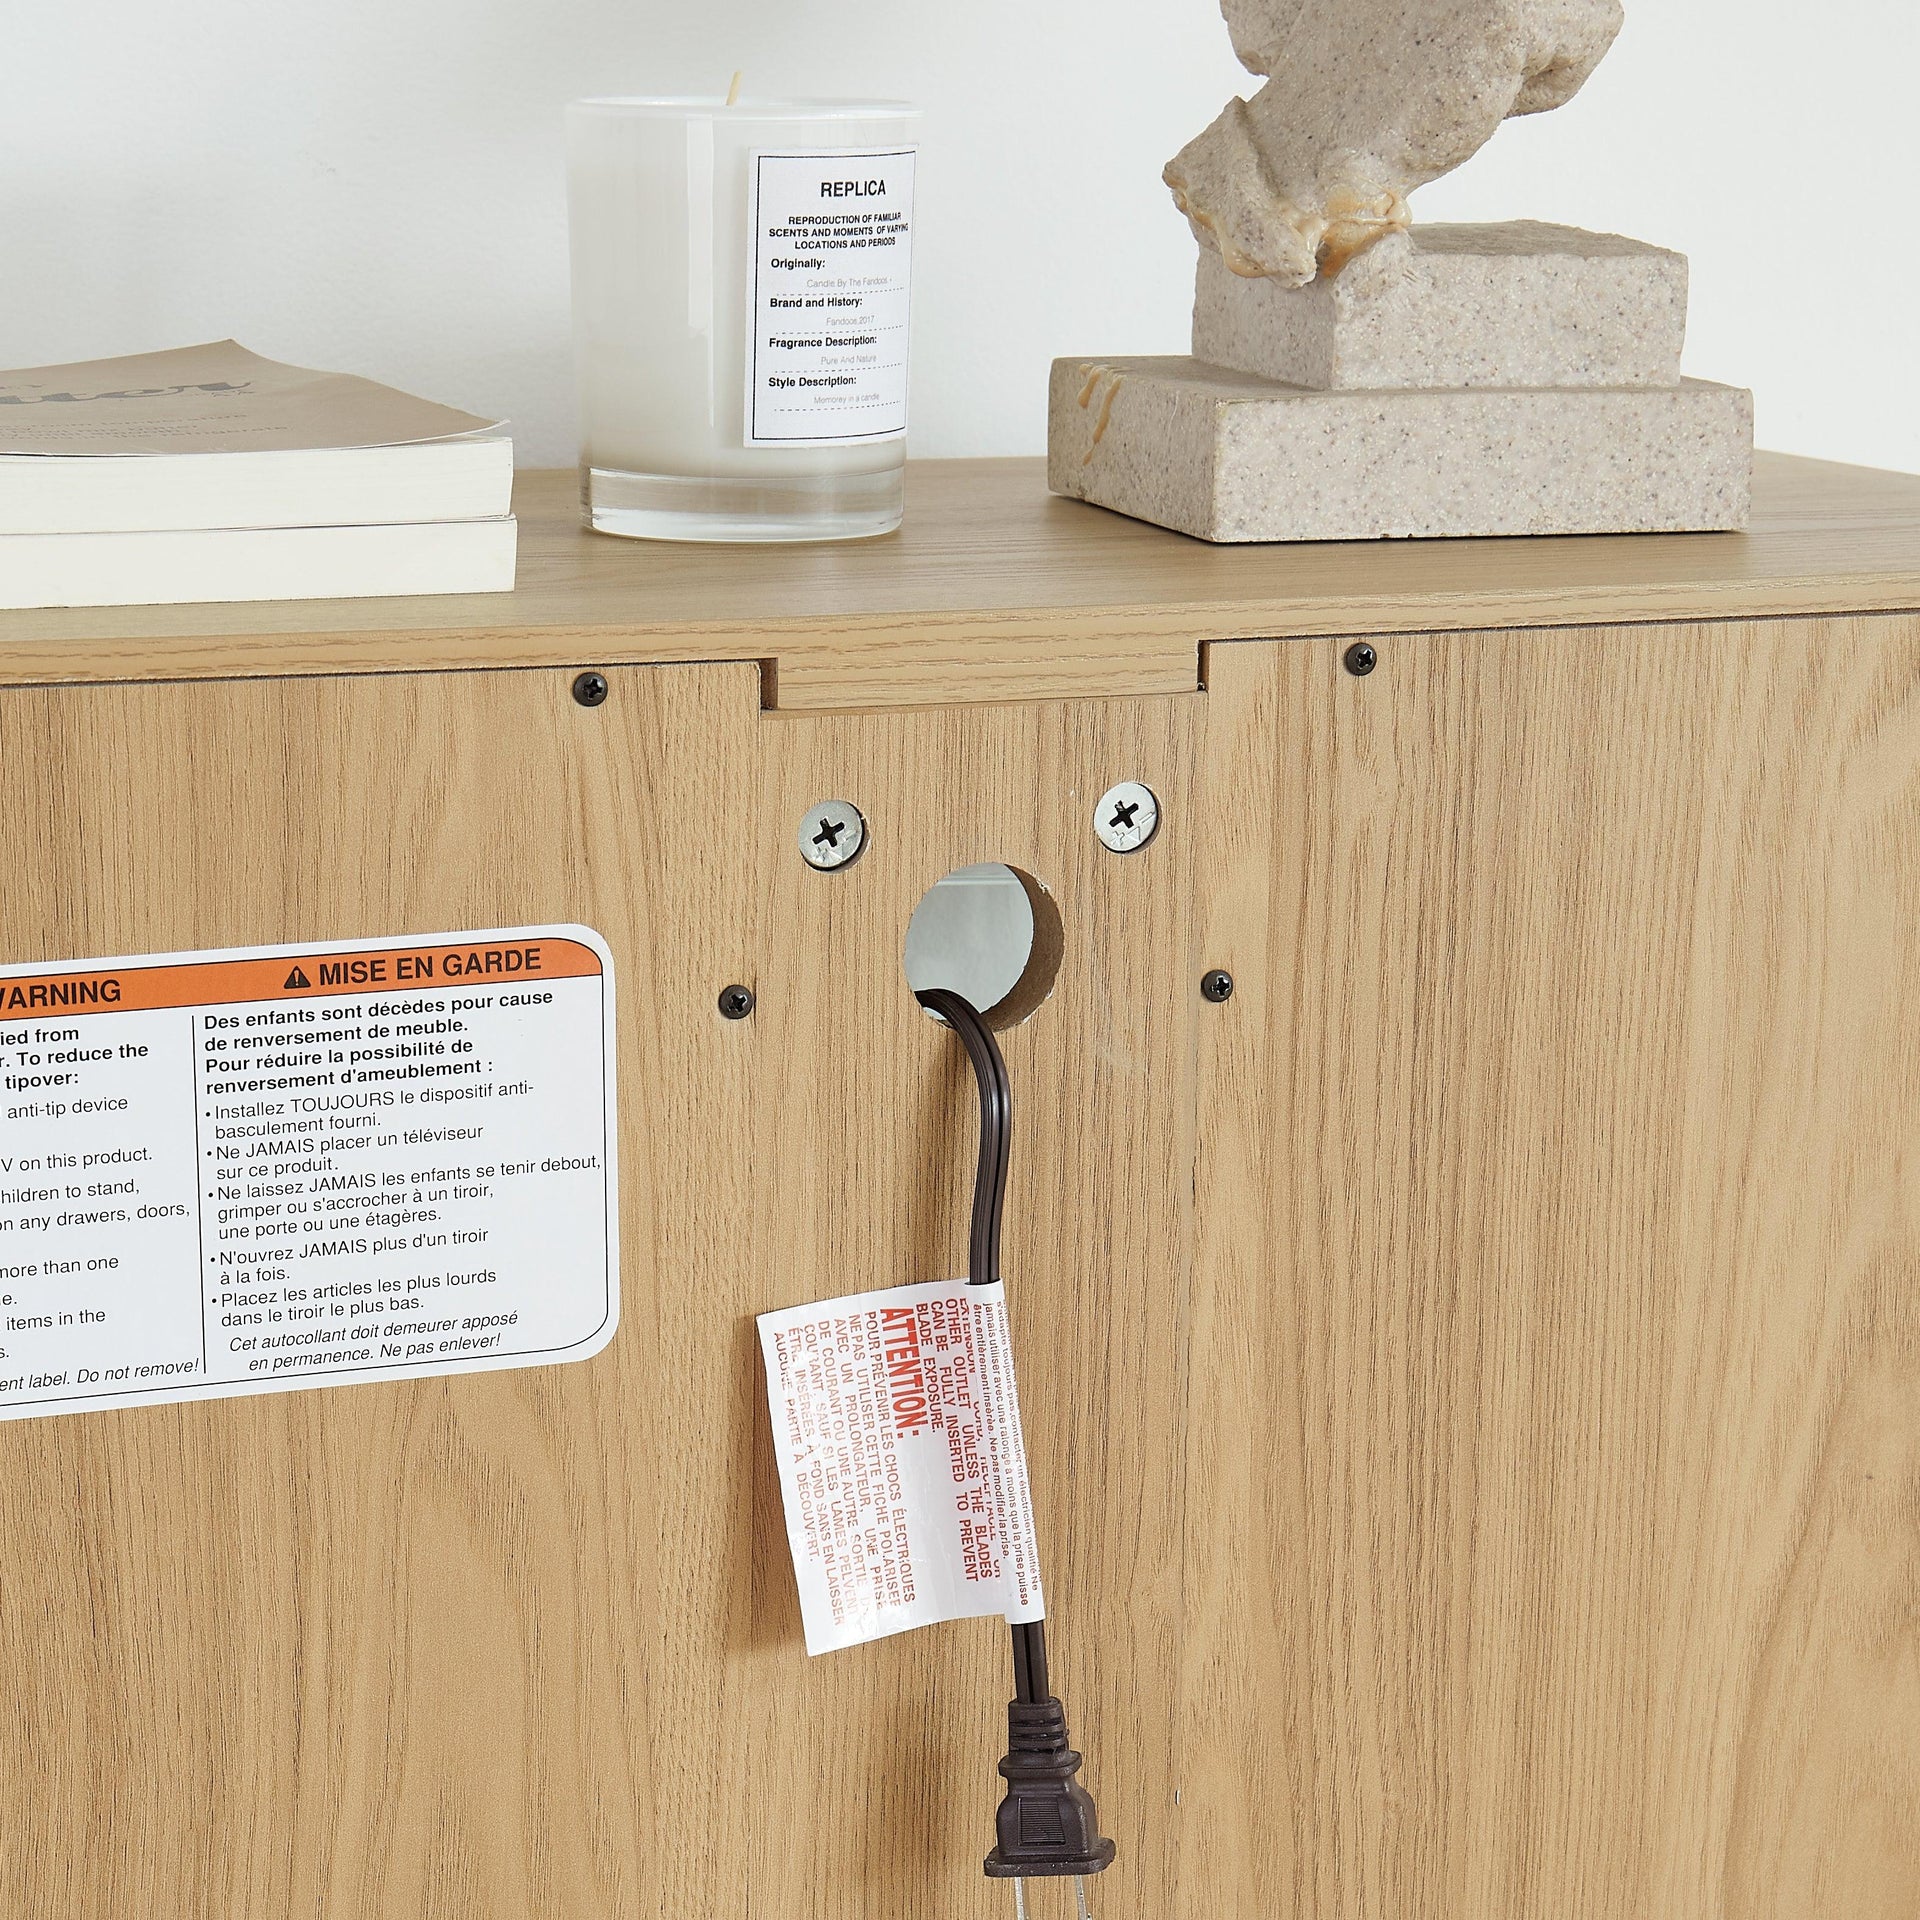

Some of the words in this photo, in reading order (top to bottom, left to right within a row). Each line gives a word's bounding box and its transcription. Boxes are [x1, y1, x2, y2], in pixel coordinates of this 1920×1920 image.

[821, 180, 886, 197] REPLICA
[769, 229, 808, 237] SCENTS
[811, 228, 831, 236] AND
[834, 227, 873, 236] MOMENTS
[877, 226, 885, 234] OF
[789, 214, 860, 224] REPRODUCTION
[862, 215, 872, 223] OF
[874, 212, 901, 222] FAMILIAR
[795, 239, 847, 249] LOCATIONS
[850, 238, 866, 248] AND
[868, 237, 895, 247] PERIODS
[771, 258, 825, 270] Originally:
[770, 298, 802, 308] Brand
[806, 298, 824, 307] and
[827, 297, 862, 307] History:
[769, 338, 822, 349] Fragrance
[826, 336, 876, 347] Description:
[769, 377, 795, 389] Style
[799, 376, 856, 387] Description:
[320, 959, 387, 986] MISE
[397, 956, 433, 980] EN
[443, 948, 541, 976] GARDE
[205, 1015, 240, 1030] Des
[246, 1009, 315, 1027] enfants
[322, 1005, 362, 1021] sont
[451, 997, 493, 1014] pour
[499, 993, 553, 1007] cause
[35, 1029, 79, 1043] from
[205, 1037, 227, 1051] de
[234, 1026, 362, 1049] renversement
[368, 1024, 390, 1039] de
[396, 1019, 468, 1036] meuble.
[16, 1052, 41, 1066] To
[48, 1048, 113, 1064] reduce
[119, 1044, 148, 1058] the
[206, 1059, 250, 1073] Pour
[256, 1052, 322, 1069] réduire
[329, 1049, 343, 1063] la
[350, 1040, 445, 1065] possibilité
[451, 1039, 473, 1053] de
[5, 1073, 78, 1092] tipover:
[207, 1072, 335, 1094] renversement
[341, 1060, 481, 1084] d'ameublement
[8, 1101, 66, 1119] anti-tip
[72, 1097, 128, 1113] device
[216, 1102, 285, 1119] Installez
[290, 1091, 394, 1113] TOUJOURS
[401, 1090, 414, 1104] le
[420, 1083, 492, 1104] dispositif
[498, 1080, 533, 1096] anti-
[215, 1118, 324, 1139] basculement
[329, 1112, 381, 1129] fourni.
[217, 1145, 240, 1160] Ne
[246, 1138, 314, 1158] JAMAIS
[321, 1136, 372, 1155] placer
[378, 1134, 397, 1146] un
[403, 1127, 483, 1144] téléviseur
[19, 1159, 40, 1171] on
[47, 1153, 77, 1169] this
[83, 1147, 152, 1169] product.
[217, 1167, 243, 1180] sur
[249, 1165, 268, 1177] ce
[275, 1156, 338, 1178] produit.
[65, 1185, 81, 1199] to
[88, 1178, 139, 1196] stand,
[218, 1186, 241, 1200] Ne
[247, 1183, 304, 1198] laissez
[309, 1173, 376, 1192] JAMAIS
[382, 1172, 405, 1186] les
[411, 1167, 470, 1183] enfants
[476, 1166, 495, 1178] se
[500, 1160, 536, 1176] tenir
[541, 1155, 600, 1172] debout,
[20, 1216, 51, 1231] any
[57, 1210, 130, 1226] drawers,
[137, 1204, 189, 1219] doors,
[218, 1204, 282, 1224] grimper
[287, 1202, 307, 1214] ou
[313, 1192, 407, 1212] s'accrocher
[413, 1188, 423, 1203] à
[428, 1190, 447, 1201] un
[453, 1183, 493, 1199] tiroir,
[219, 1227, 249, 1240] une
[256, 1221, 297, 1240] porte
[303, 1220, 323, 1232] ou
[330, 1217, 359, 1230] une
[366, 1209, 441, 1227] étagères.
[220, 1249, 294, 1265] N'ouvrez
[299, 1239, 367, 1258] JAMAIS
[373, 1237, 407, 1255] plus
[412, 1233, 446, 1248] d'un
[452, 1228, 488, 1244] tiroir
[43, 1260, 80, 1275] than
[87, 1258, 119, 1271] one
[220, 1271, 230, 1285] à
[237, 1270, 251, 1283] la
[256, 1266, 290, 1282] fois.
[222, 1292, 277, 1307] Placez
[284, 1288, 307, 1302] les
[313, 1282, 372, 1299] articles
[378, 1279, 401, 1292] les
[407, 1275, 440, 1293] plus
[447, 1269, 496, 1286] lourds
[7, 1316, 52, 1330] items
[59, 1312, 73, 1325] in
[79, 1309, 105, 1324] the
[221, 1313, 262, 1327] dans
[268, 1309, 282, 1322] le
[288, 1304, 325, 1320] tiroir
[331, 1303, 344, 1316] le
[350, 1300, 384, 1318] plus
[390, 1297, 424, 1311] bas.
[915, 1303, 932, 1346] BLADE
[930, 1301, 945, 1330] CAN
[945, 1298, 961, 1344] OTHER
[230, 1337, 257, 1352] Cet
[261, 1328, 346, 1349] autocollant
[351, 1324, 379, 1340] doit
[383, 1319, 458, 1337] demeurer
[462, 1310, 518, 1332] apposé
[864, 1311, 880, 1350] POUR
[934, 1335, 948, 1352] BE
[249, 1359, 268, 1371] en
[272, 1349, 373, 1372] permanence.
[380, 1343, 401, 1358] Ne
[406, 1342, 434, 1359] pas
[439, 1332, 501, 1352] enlever!
[29, 1371, 70, 1388] label.
[77, 1369, 99, 1383] Do
[105, 1366, 130, 1380] not
[134, 1358, 199, 1377] remove!
[879, 1308, 928, 1438] ATTENTION:
[938, 1366, 955, 1406] FULLY
[952, 1356, 970, 1409] OUTLET
[922, 1357, 943, 1433] EXPOSURE.
[879, 1424, 894, 1450] LES
[945, 1415, 964, 1482] INSERTED
[961, 1424, 979, 1479] UNLESS
[884, 1454, 901, 1501] CHOCS
[955, 1492, 968, 1511] TO
[969, 1486, 984, 1513] THE
[958, 1519, 978, 1582] PREVENT
[974, 1525, 992, 1578] BLADES
